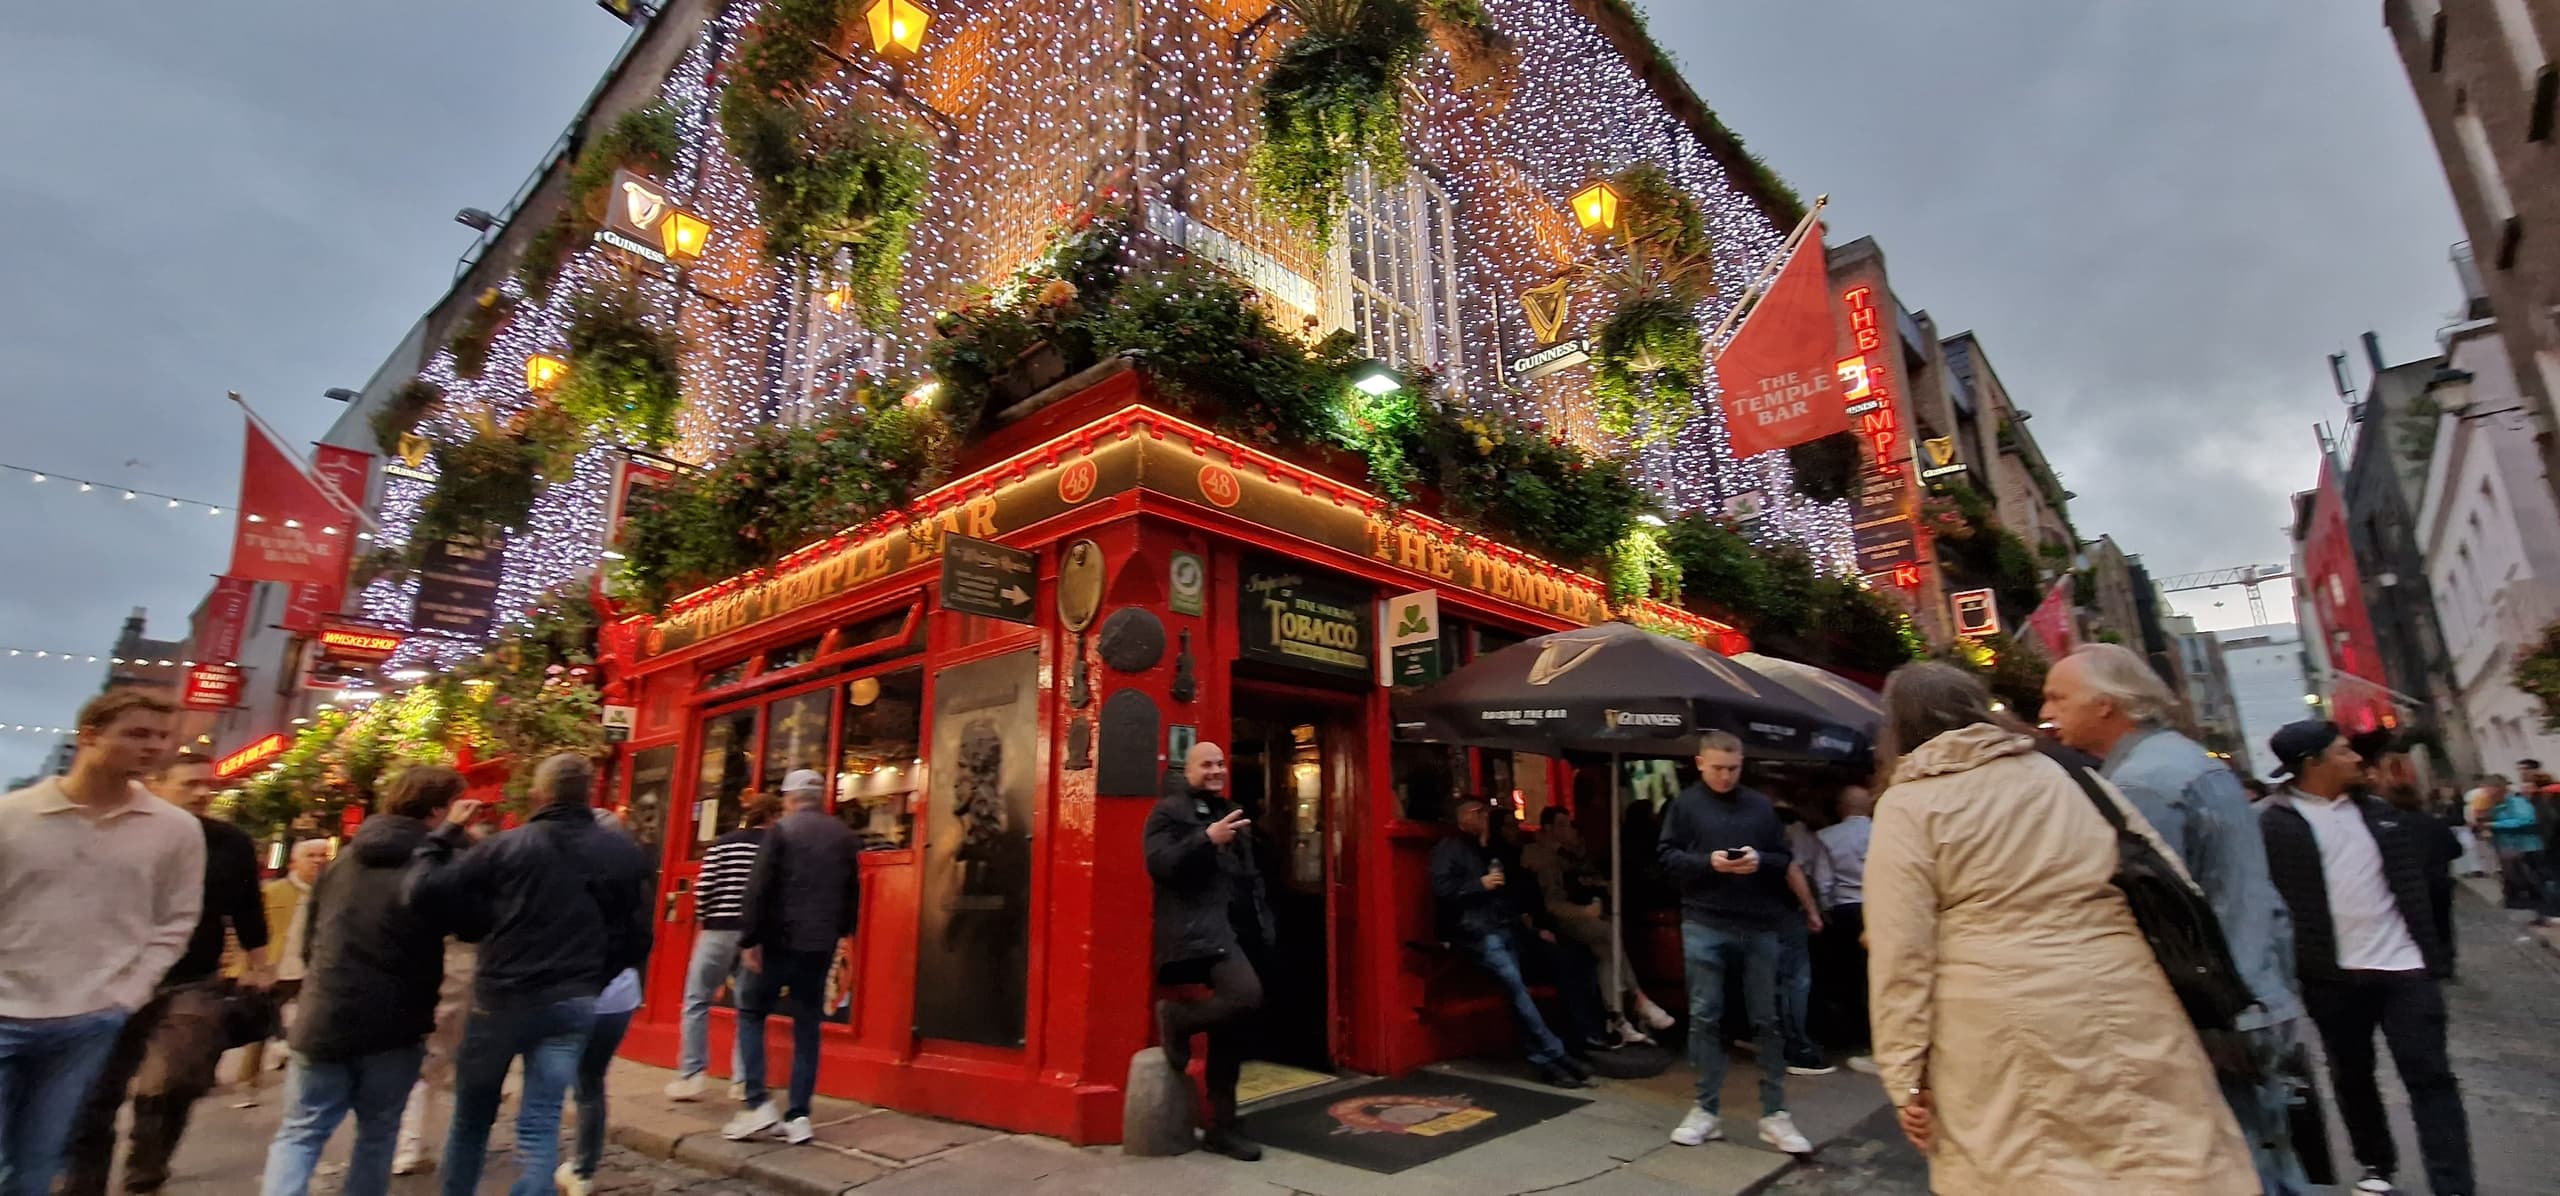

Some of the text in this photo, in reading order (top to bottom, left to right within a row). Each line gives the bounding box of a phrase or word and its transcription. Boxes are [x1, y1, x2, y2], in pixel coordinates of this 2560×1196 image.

[603, 231, 666, 264] GUINNESS
[1844, 286, 1880, 350] THE
[1514, 340, 1578, 372] GUINNESS
[1731, 375, 1833, 416] TEMPLE
[1757, 372, 1801, 392] THE
[1757, 401, 1809, 426] BAR
[1064, 467, 1091, 496] 48
[1205, 472, 1231, 501] 48
[908, 497, 999, 564] BAR
[1368, 519, 1454, 580] THE
[1465, 550, 1592, 626] TEMPLE
[325, 631, 396, 650] WHISKEY SHOP
[1263, 598, 1358, 651] TOBACCO
[1618, 711, 1682, 726] GUINNESS
